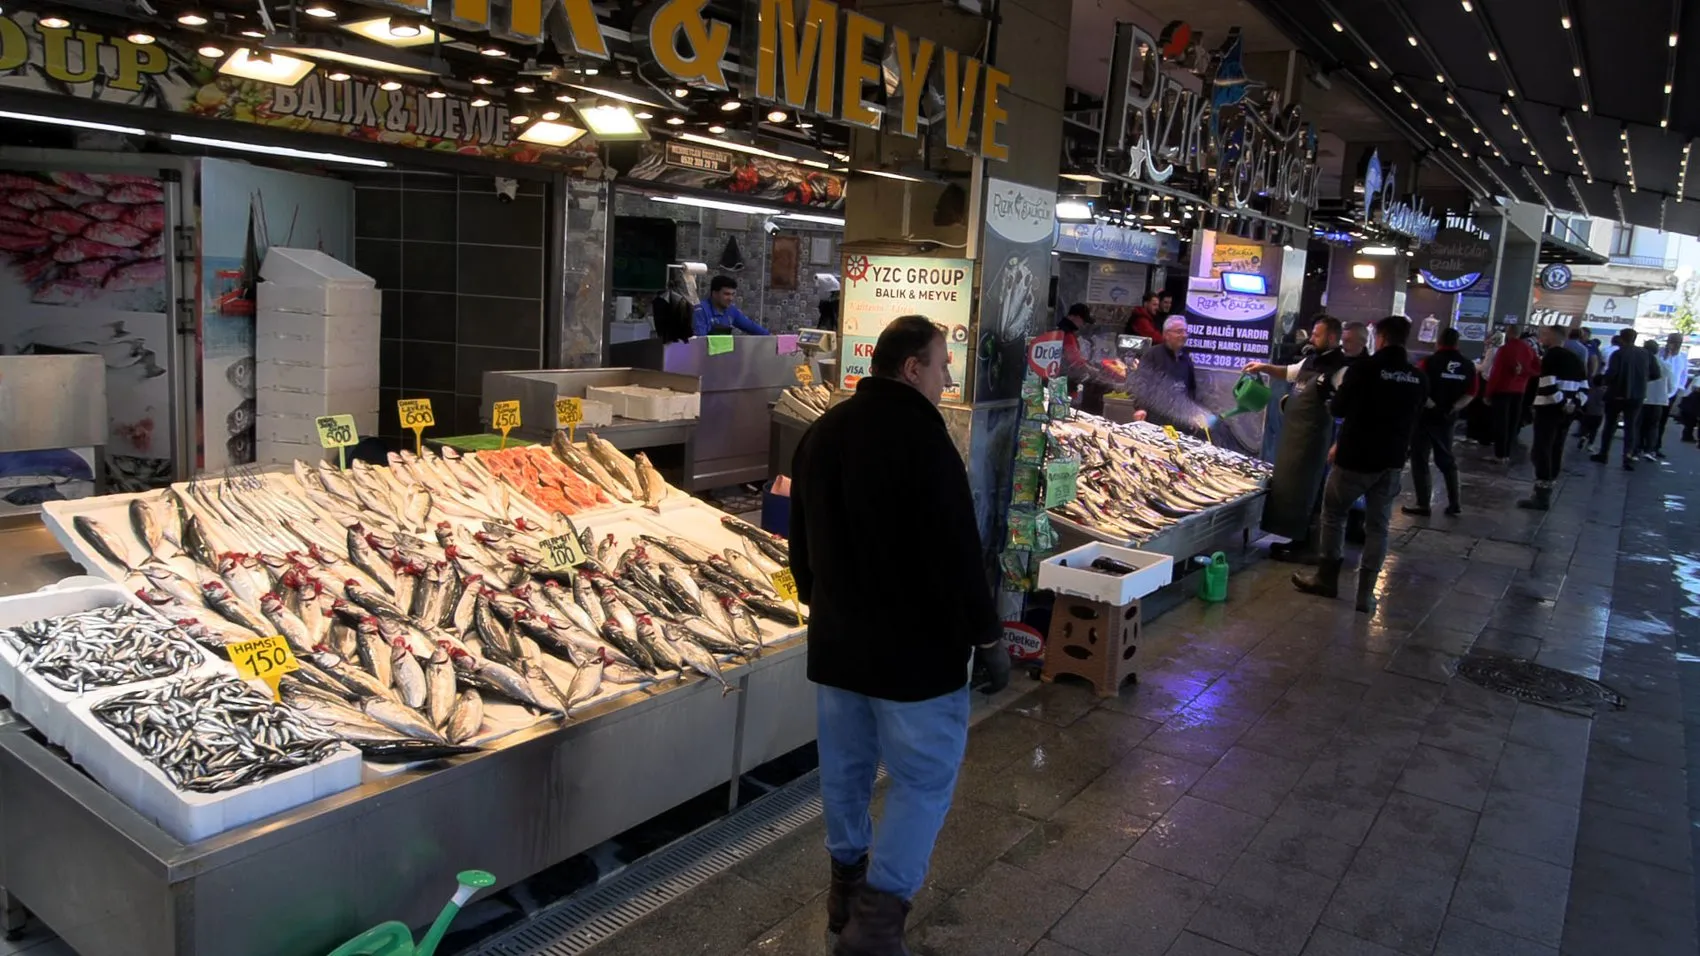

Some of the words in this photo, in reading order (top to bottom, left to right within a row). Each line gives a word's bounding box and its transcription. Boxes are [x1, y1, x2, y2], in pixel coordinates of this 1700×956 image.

[756, 0, 1010, 163] MEYVE
[272, 75, 378, 127] BALIK
[385, 88, 410, 132] &
[415, 90, 511, 147] MEYVE
[873, 266, 901, 282] YZC
[907, 268, 964, 286] GROUP
[876, 288, 907, 299] BALIK
[908, 291, 916, 299] &
[919, 290, 957, 301] MEYVE
[1187, 324, 1204, 335] BUZ
[1206, 325, 1235, 337] BALIĞI
[1236, 328, 1269, 340] VARDIR
[1243, 343, 1269, 354] VARDIR
[1213, 355, 1231, 367] 308
[846, 365, 864, 375] VISA
[406, 411, 432, 425] 600
[551, 546, 576, 567] 100
[1009, 632, 1040, 649] Oetker
[245, 646, 287, 676] 150
